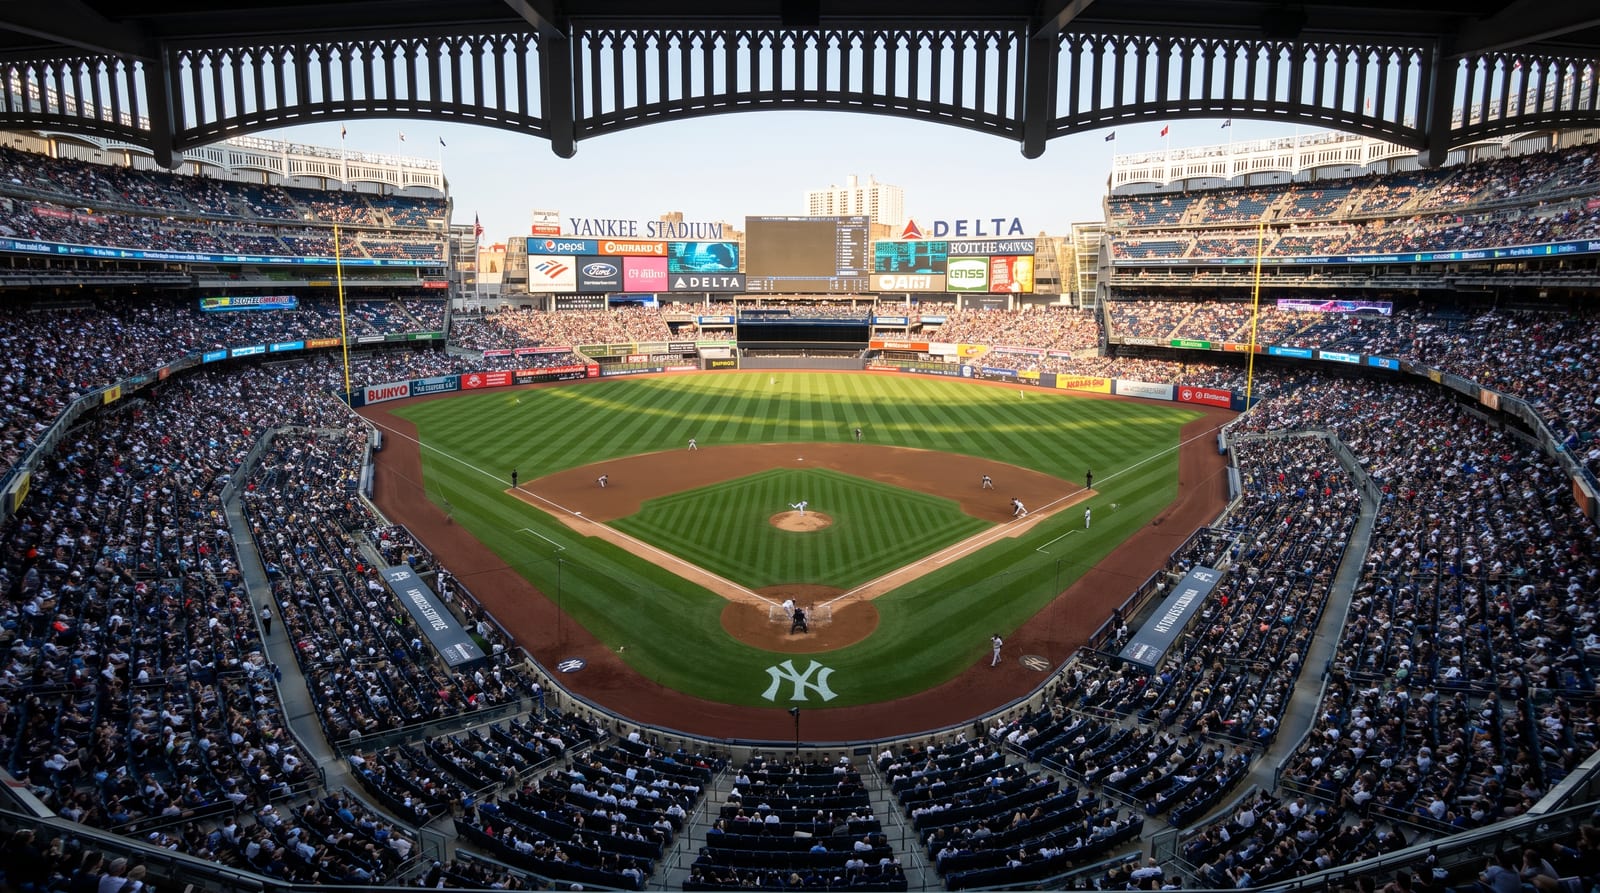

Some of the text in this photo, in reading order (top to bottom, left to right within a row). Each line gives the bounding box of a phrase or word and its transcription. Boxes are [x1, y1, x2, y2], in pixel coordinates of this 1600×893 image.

[569, 217, 723, 240] YANKEE STADIUM
[933, 217, 1025, 238] DELTA
[557, 242, 586, 252] pepsi
[588, 263, 612, 276] Ford
[689, 276, 740, 288] DELTA
[761, 659, 839, 702] NY
